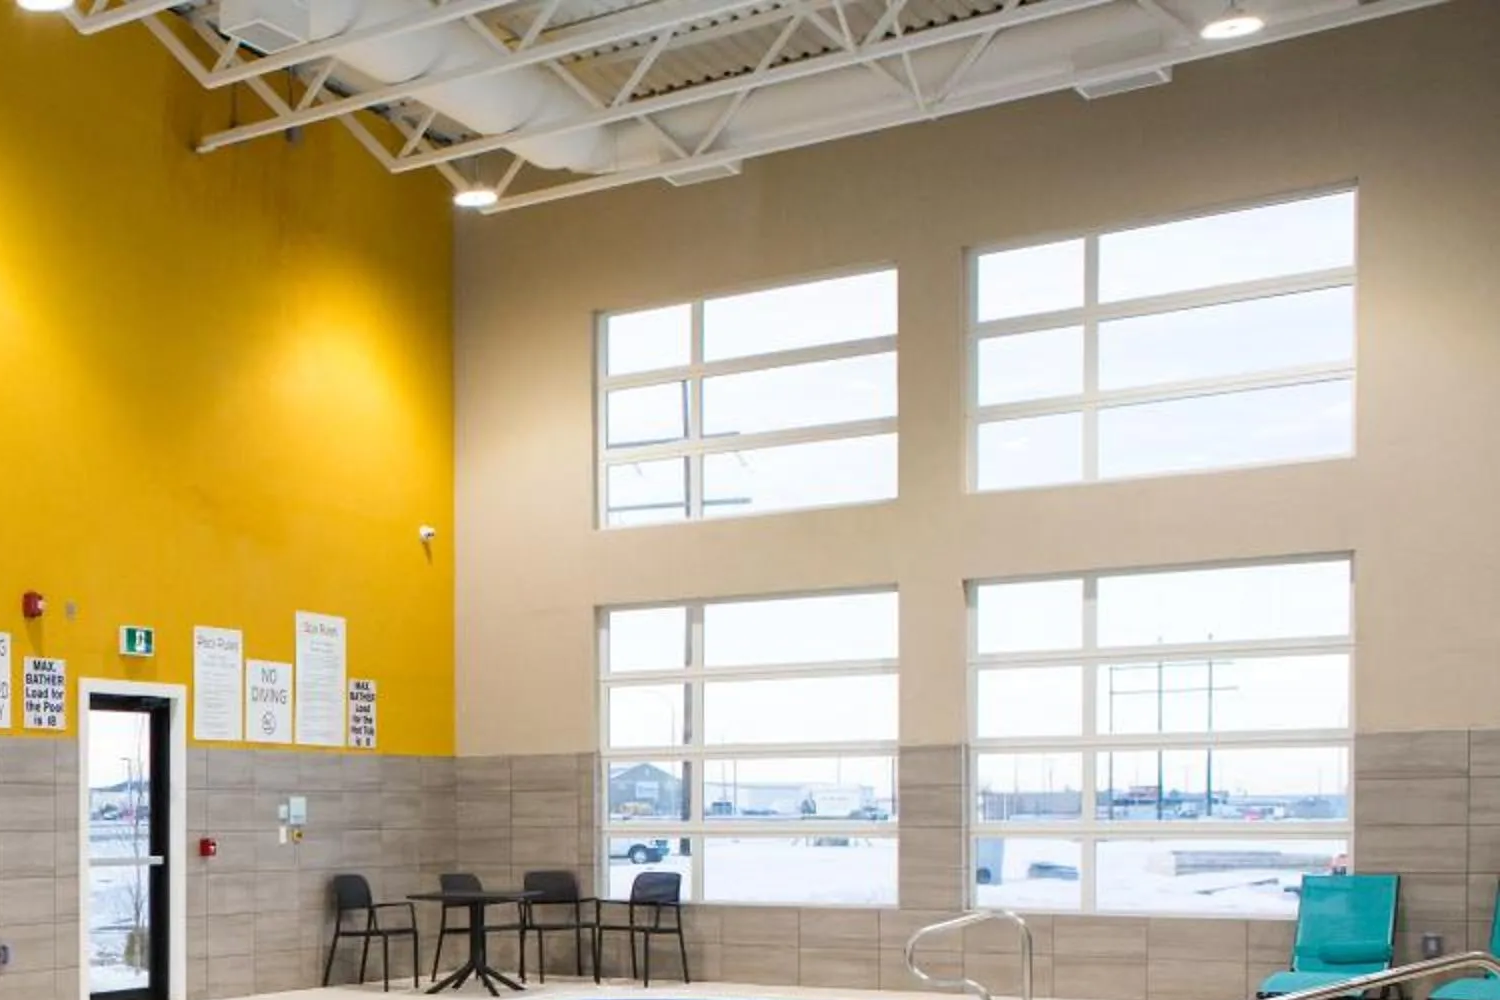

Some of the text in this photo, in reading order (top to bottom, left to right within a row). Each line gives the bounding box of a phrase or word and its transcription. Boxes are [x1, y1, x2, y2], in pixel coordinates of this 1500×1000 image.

[25, 673, 65, 687] BATHER
[261, 668, 277, 684] NO
[251, 686, 288, 705] DIVING
